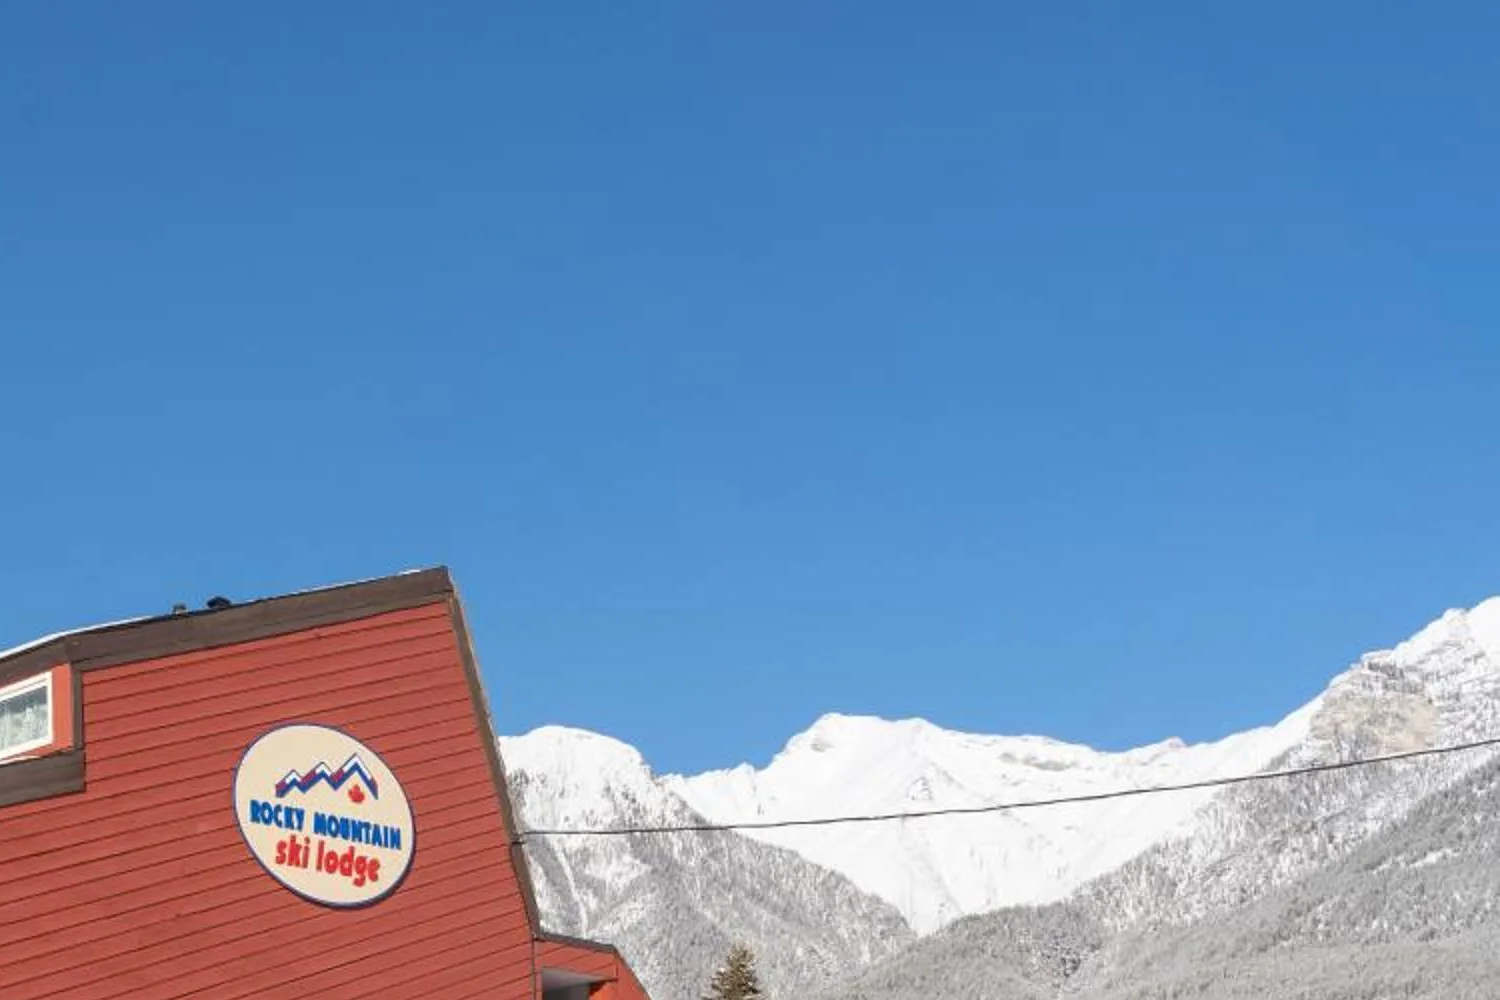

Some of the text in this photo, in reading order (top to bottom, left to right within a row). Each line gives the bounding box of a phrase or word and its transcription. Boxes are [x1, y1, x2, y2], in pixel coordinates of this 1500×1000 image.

[249, 800, 401, 850] ROCKY MOUNTAIN
[275, 834, 380, 887] ski lodge
